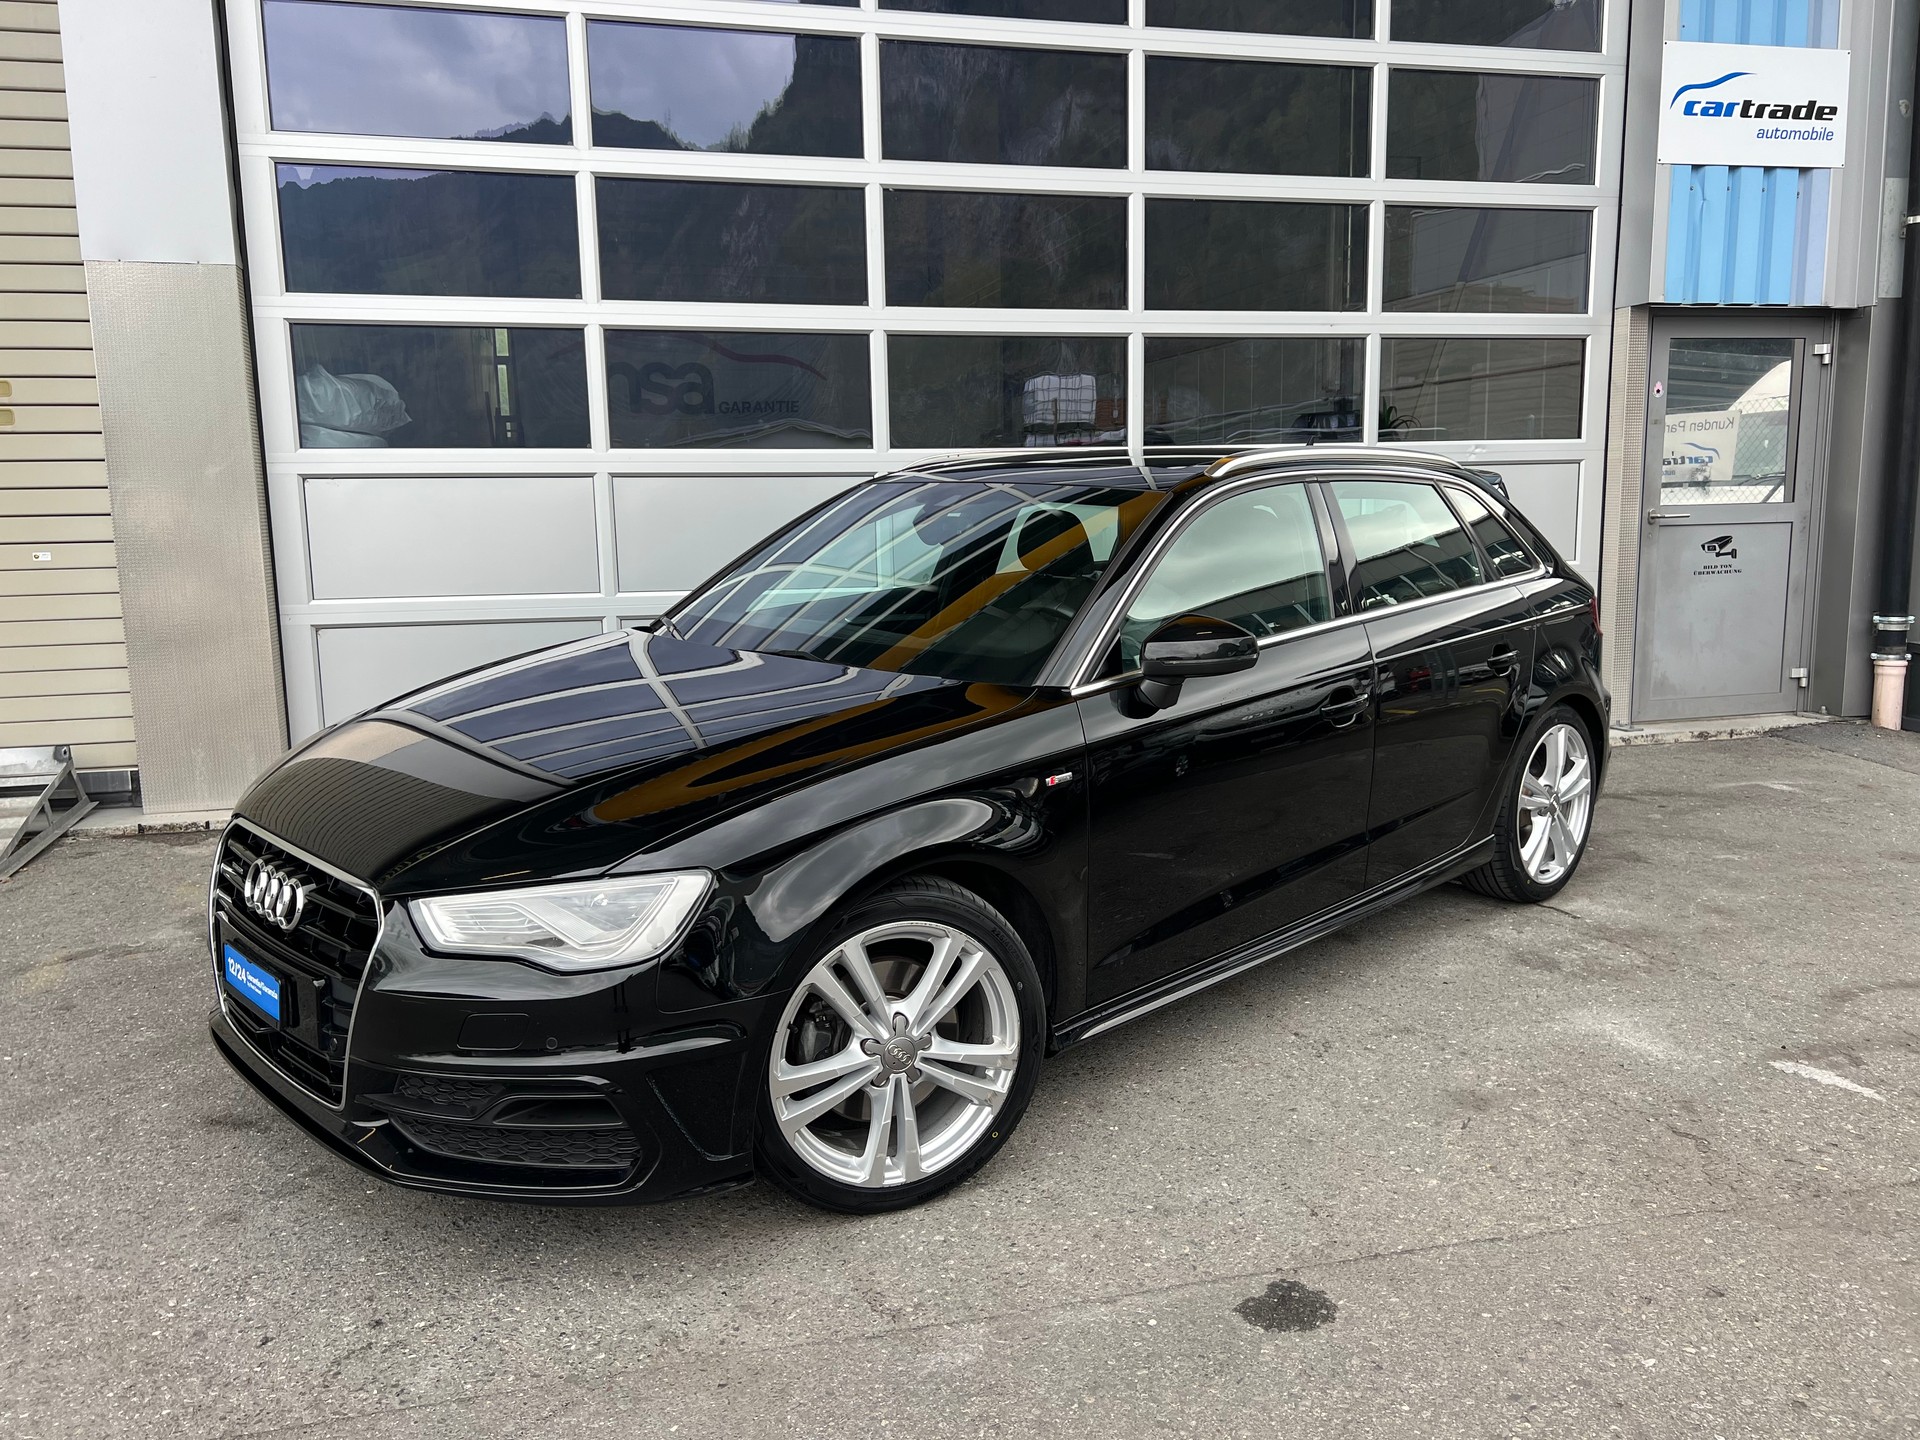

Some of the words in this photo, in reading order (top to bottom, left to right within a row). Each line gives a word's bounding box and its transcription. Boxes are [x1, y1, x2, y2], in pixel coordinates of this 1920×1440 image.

[1683, 99, 1838, 121] cartrade
[1756, 126, 1834, 141] automobile
[718, 400, 800, 416] GARANTIE
[228, 957, 247, 983] 12/24
